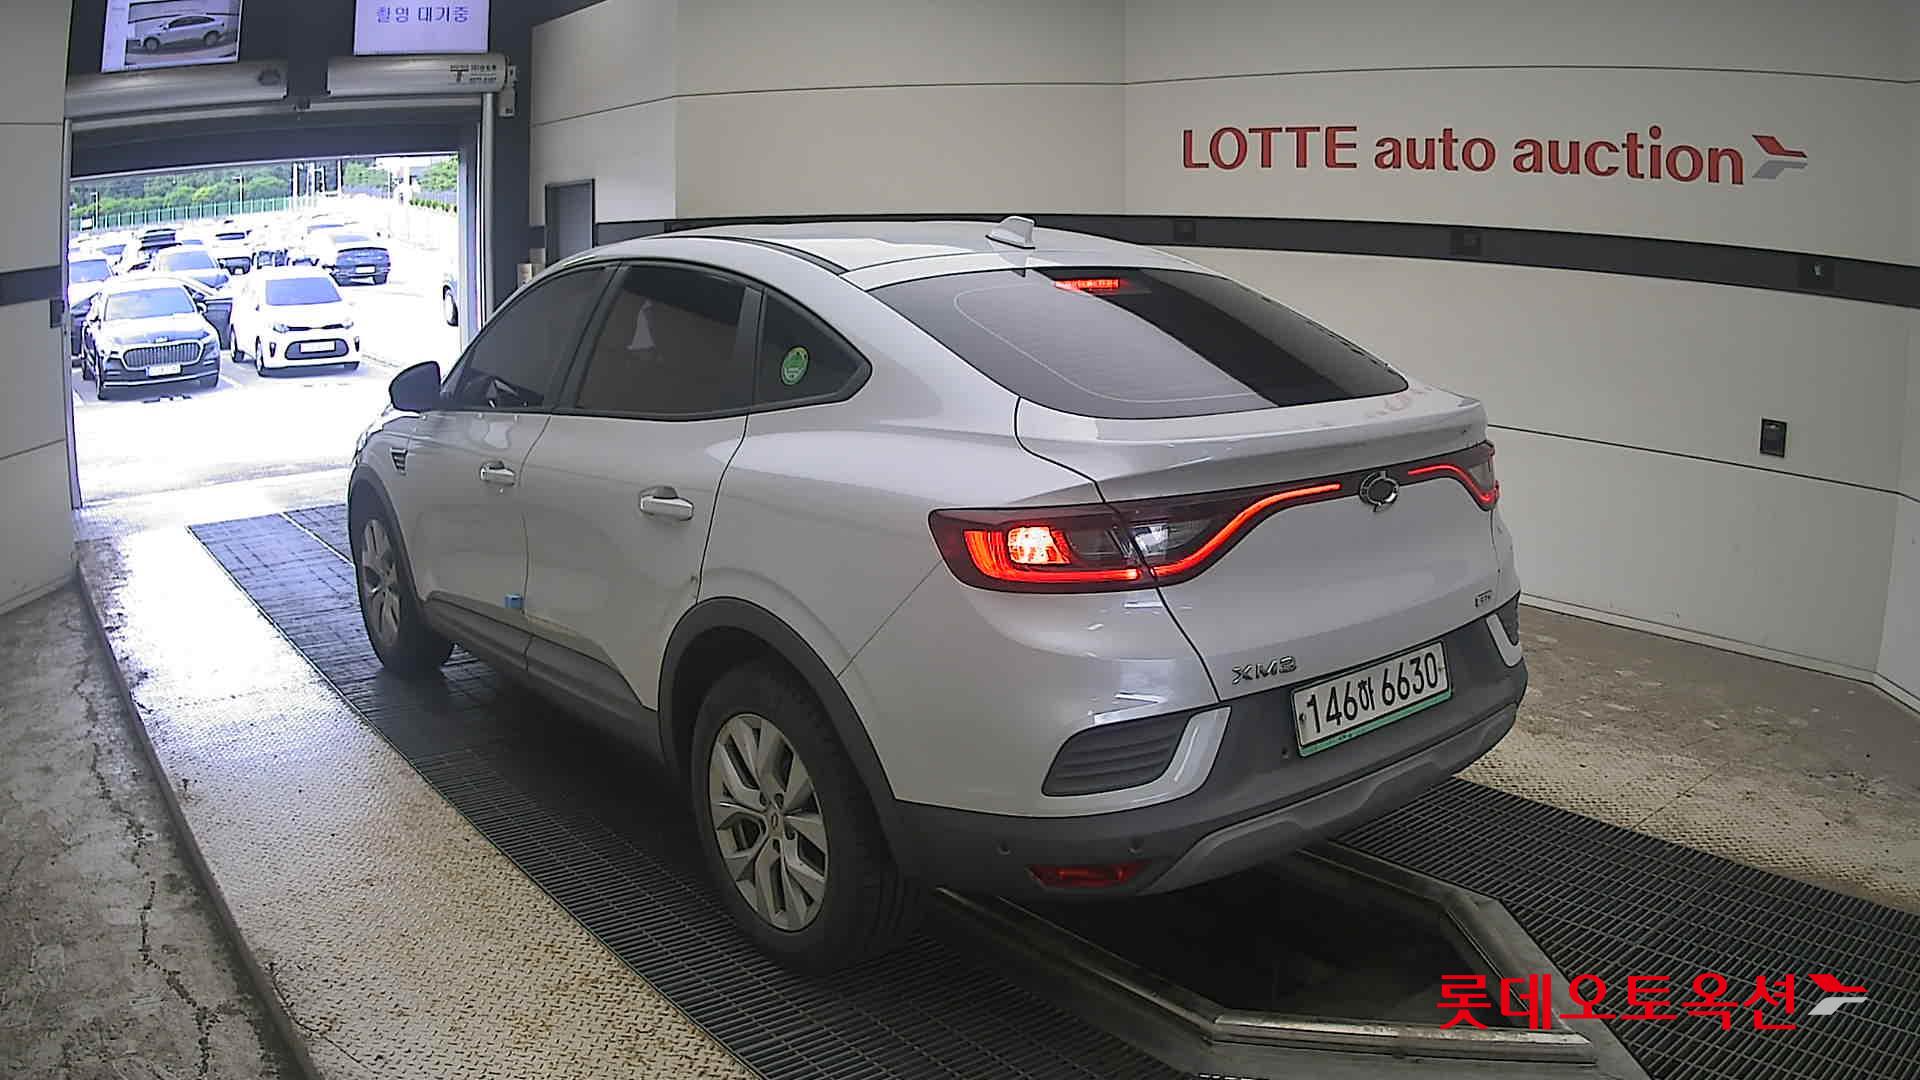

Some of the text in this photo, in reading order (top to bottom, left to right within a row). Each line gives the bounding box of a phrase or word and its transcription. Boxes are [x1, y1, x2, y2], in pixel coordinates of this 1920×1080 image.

[418, 6, 469, 23] 대기중
[1183, 125, 1744, 185] LOTTE auto auction
[1231, 655, 1297, 685] XM3
[1306, 652, 1438, 733] 146하 6630
